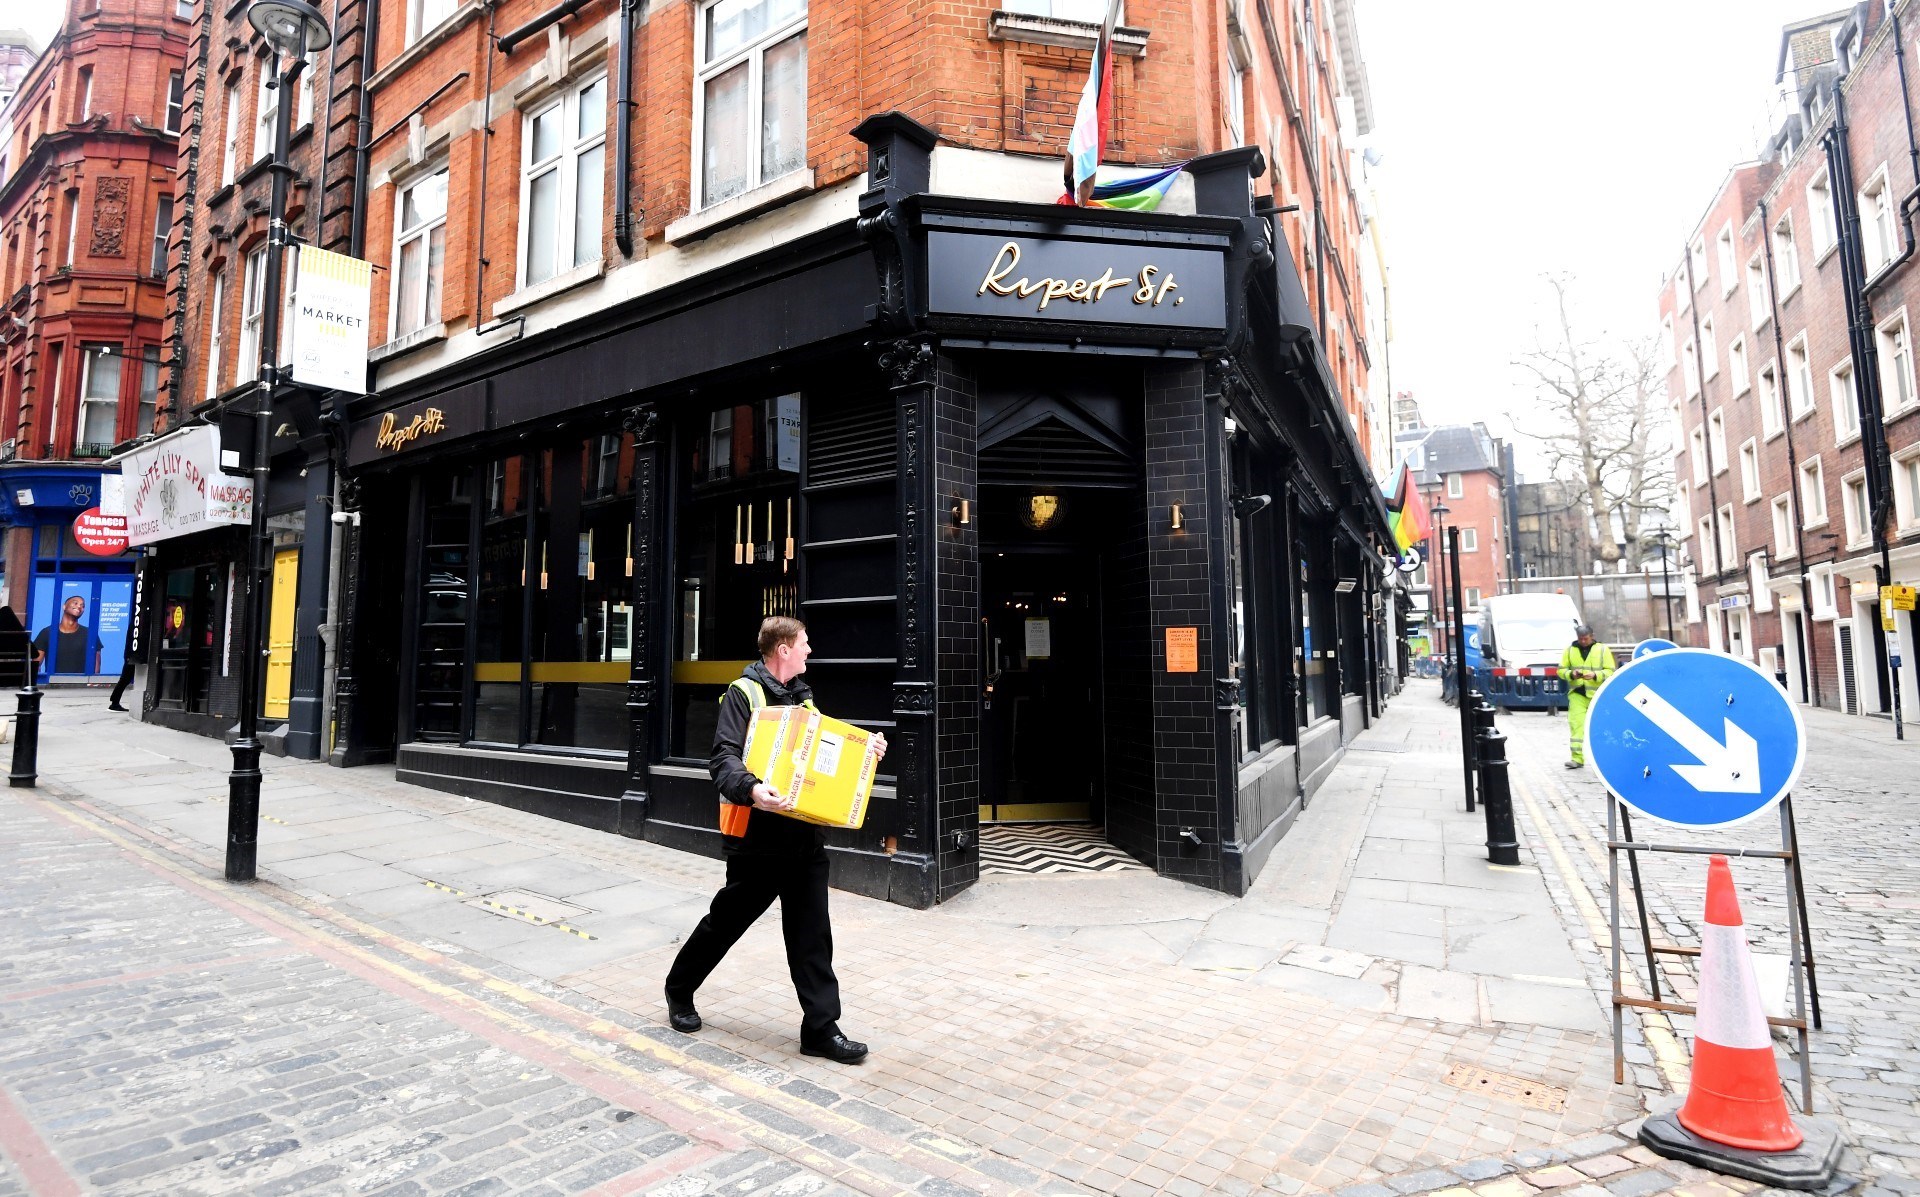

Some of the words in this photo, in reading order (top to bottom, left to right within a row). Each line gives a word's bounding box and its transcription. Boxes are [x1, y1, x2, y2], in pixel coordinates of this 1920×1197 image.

[977, 241, 1132, 312] Rupert
[1132, 264, 1184, 307] St.
[302, 306, 363, 329] MARKET
[376, 412, 427, 452] Rupert
[134, 460, 161, 517] WHITE
[162, 449, 182, 475] LILY
[185, 460, 205, 500] SPA
[210, 485, 252, 504] MASSAG
[82, 538, 105, 546] Open
[133, 520, 160, 536] MASSAGE
[132, 570, 144, 652] TOBACCO
[800, 728, 815, 761] FRAGILE
[860, 748, 874, 781] FRAGILE
[788, 773, 802, 807] FRAGILE
[849, 791, 863, 824] FRAGILE
